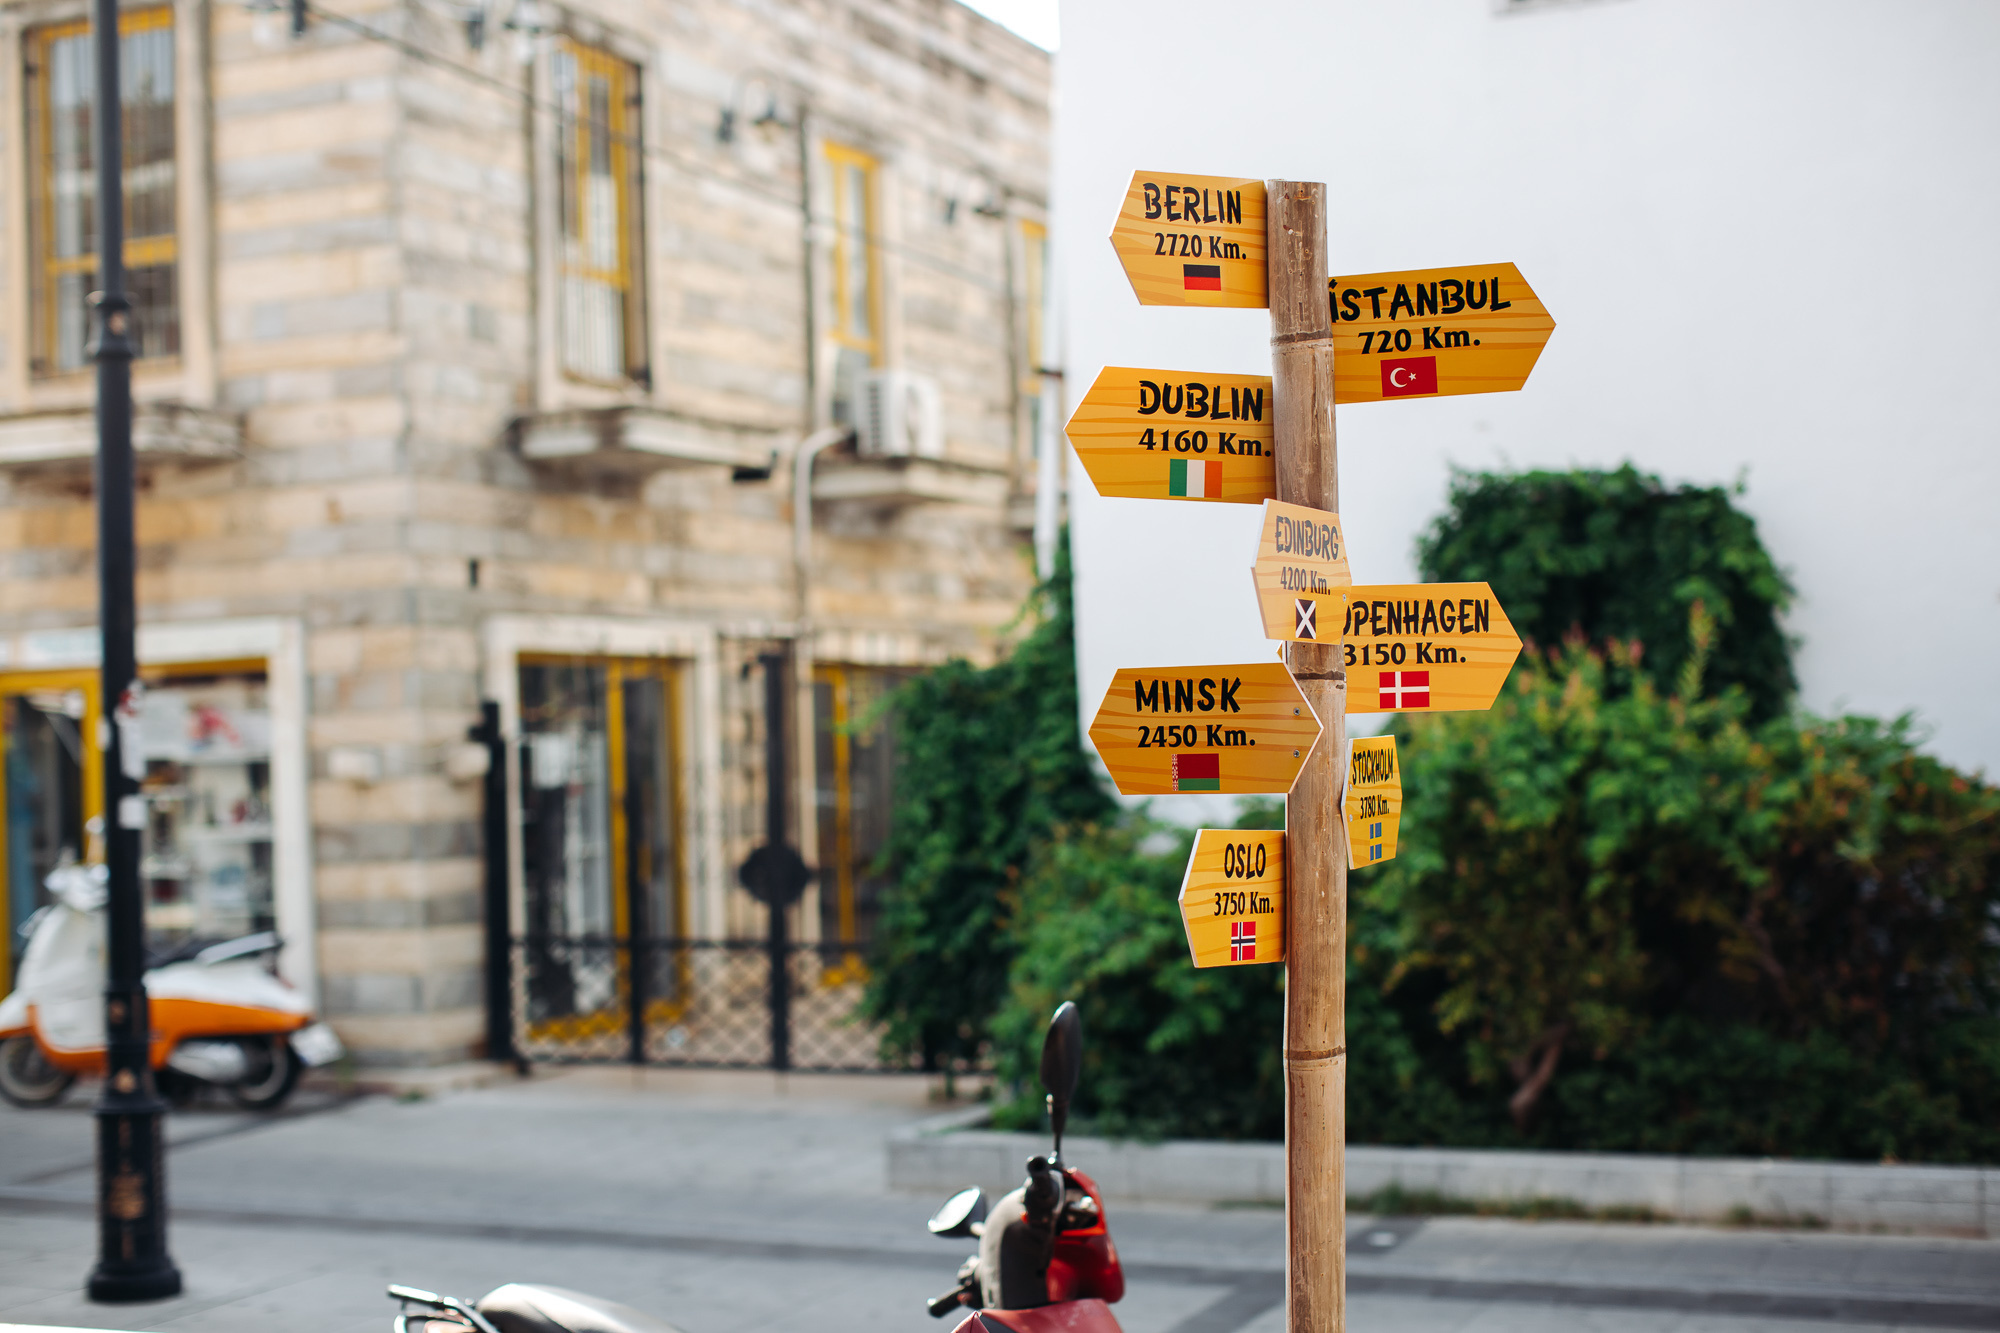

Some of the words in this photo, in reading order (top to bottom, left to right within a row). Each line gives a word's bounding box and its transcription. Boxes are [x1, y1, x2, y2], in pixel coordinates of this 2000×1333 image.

[1143, 182, 1242, 225] BERLIN
[1154, 232, 1203, 258] 2720
[1208, 235, 1247, 260] Km.
[1357, 328, 1412, 355] 720
[1421, 325, 1481, 350] Km.
[1137, 380, 1264, 423] DUBLIN
[1138, 427, 1209, 454] 4160
[1218, 431, 1272, 457] Km.
[1275, 515, 1339, 562] EDINBURG
[1280, 566, 1307, 592] 4200
[1310, 570, 1331, 596] Km.
[1344, 642, 1407, 667] 3150
[1415, 641, 1467, 665] Km.
[1134, 676, 1242, 714] MINSK
[1137, 724, 1198, 749] 2450
[1205, 723, 1257, 747] Km.
[1352, 748, 1394, 786] STOCKHOLM
[1360, 794, 1376, 820] 3780
[1377, 793, 1390, 816] Km.
[1224, 842, 1267, 880] OSLO
[1214, 891, 1246, 917] 3750
[1249, 891, 1275, 915] Km.
